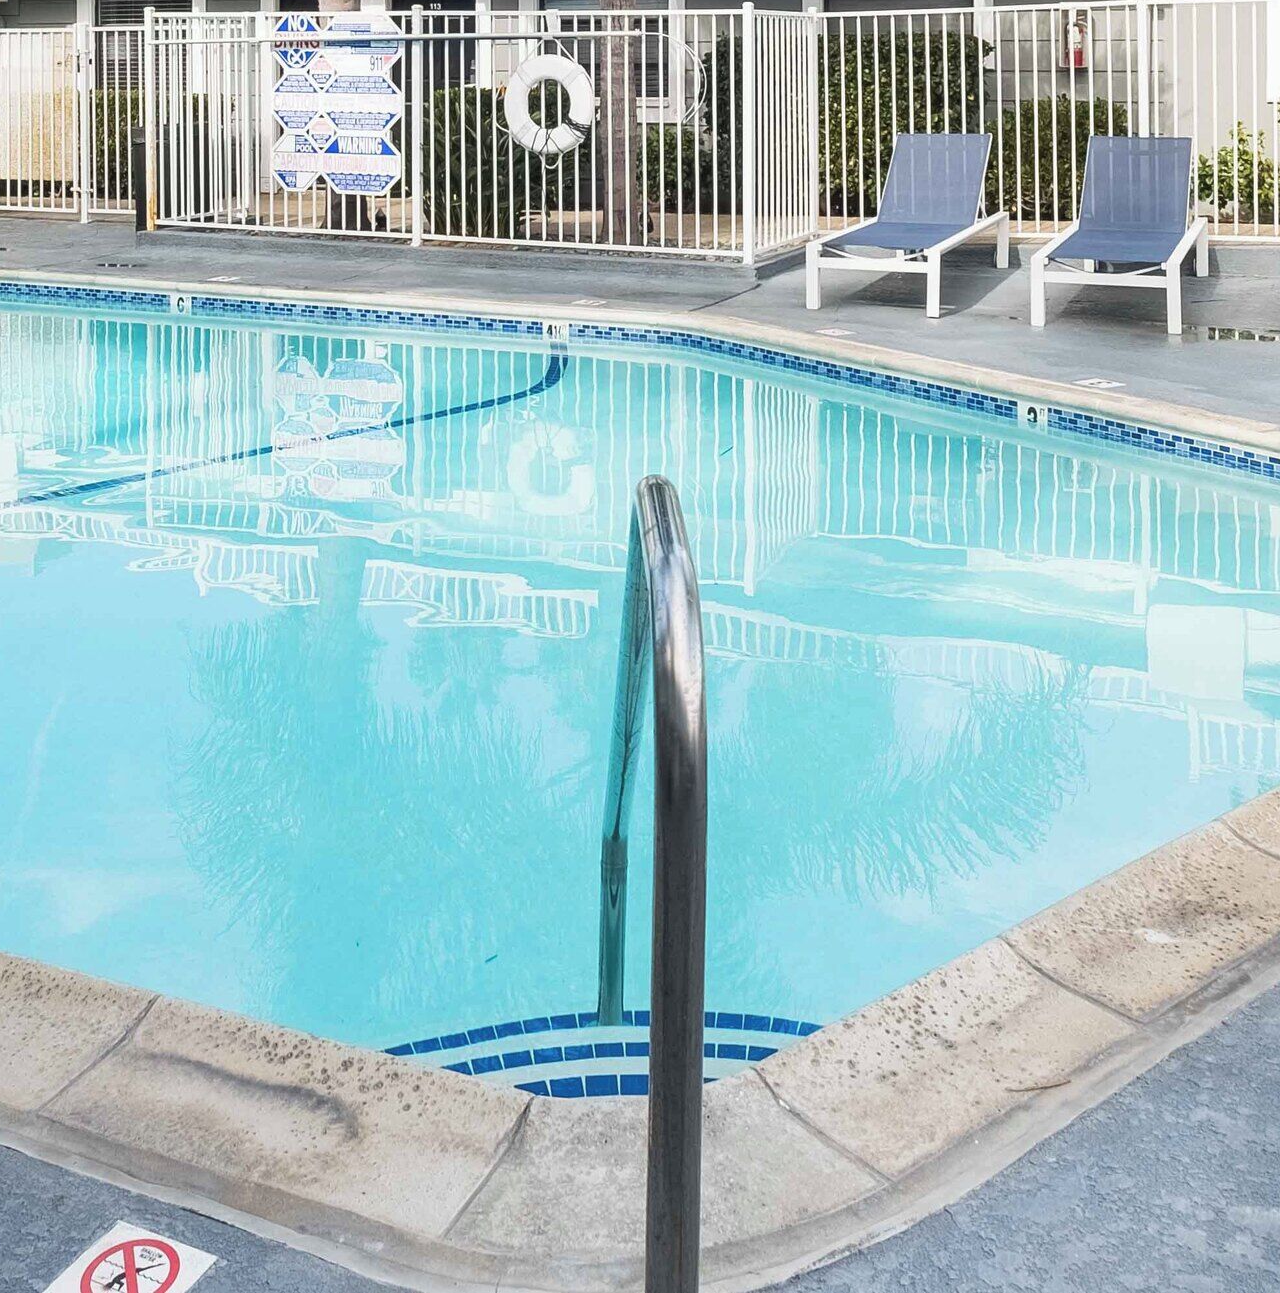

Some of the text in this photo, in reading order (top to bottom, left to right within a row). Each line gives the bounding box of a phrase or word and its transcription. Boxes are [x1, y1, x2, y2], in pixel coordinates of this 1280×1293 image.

[288, 14, 308, 32] NO
[274, 32, 320, 49] DIVING
[370, 55, 383, 72] 911
[295, 144, 313, 153] POOL
[338, 136, 382, 155] WARNING
